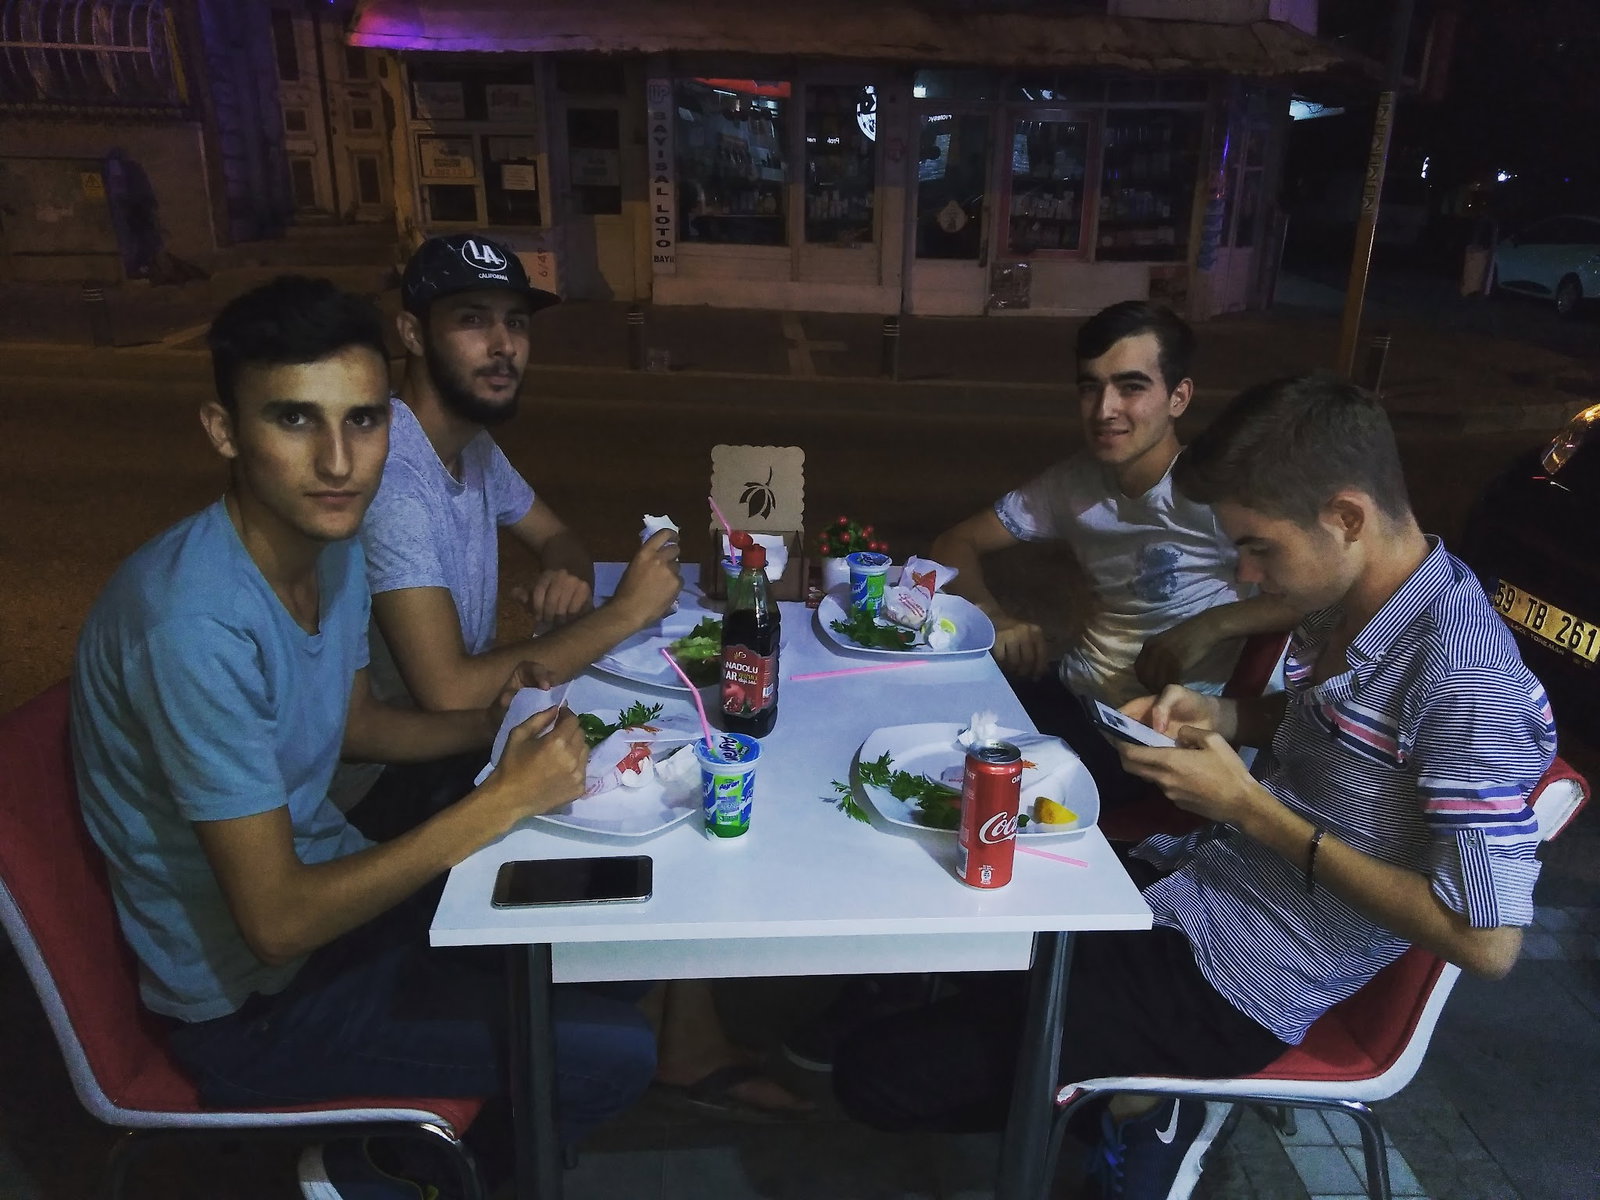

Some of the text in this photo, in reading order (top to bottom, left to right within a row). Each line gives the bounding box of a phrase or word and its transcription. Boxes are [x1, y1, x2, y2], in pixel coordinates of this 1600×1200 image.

[655, 204, 671, 248] LOTO
[468, 239, 505, 265] LA
[478, 272, 509, 282] CALIFORNIA
[1494, 582, 1517, 613] 59
[1523, 597, 1548, 630] TB
[1555, 615, 1598, 656] 261
[722, 660, 759, 674] NADOLU
